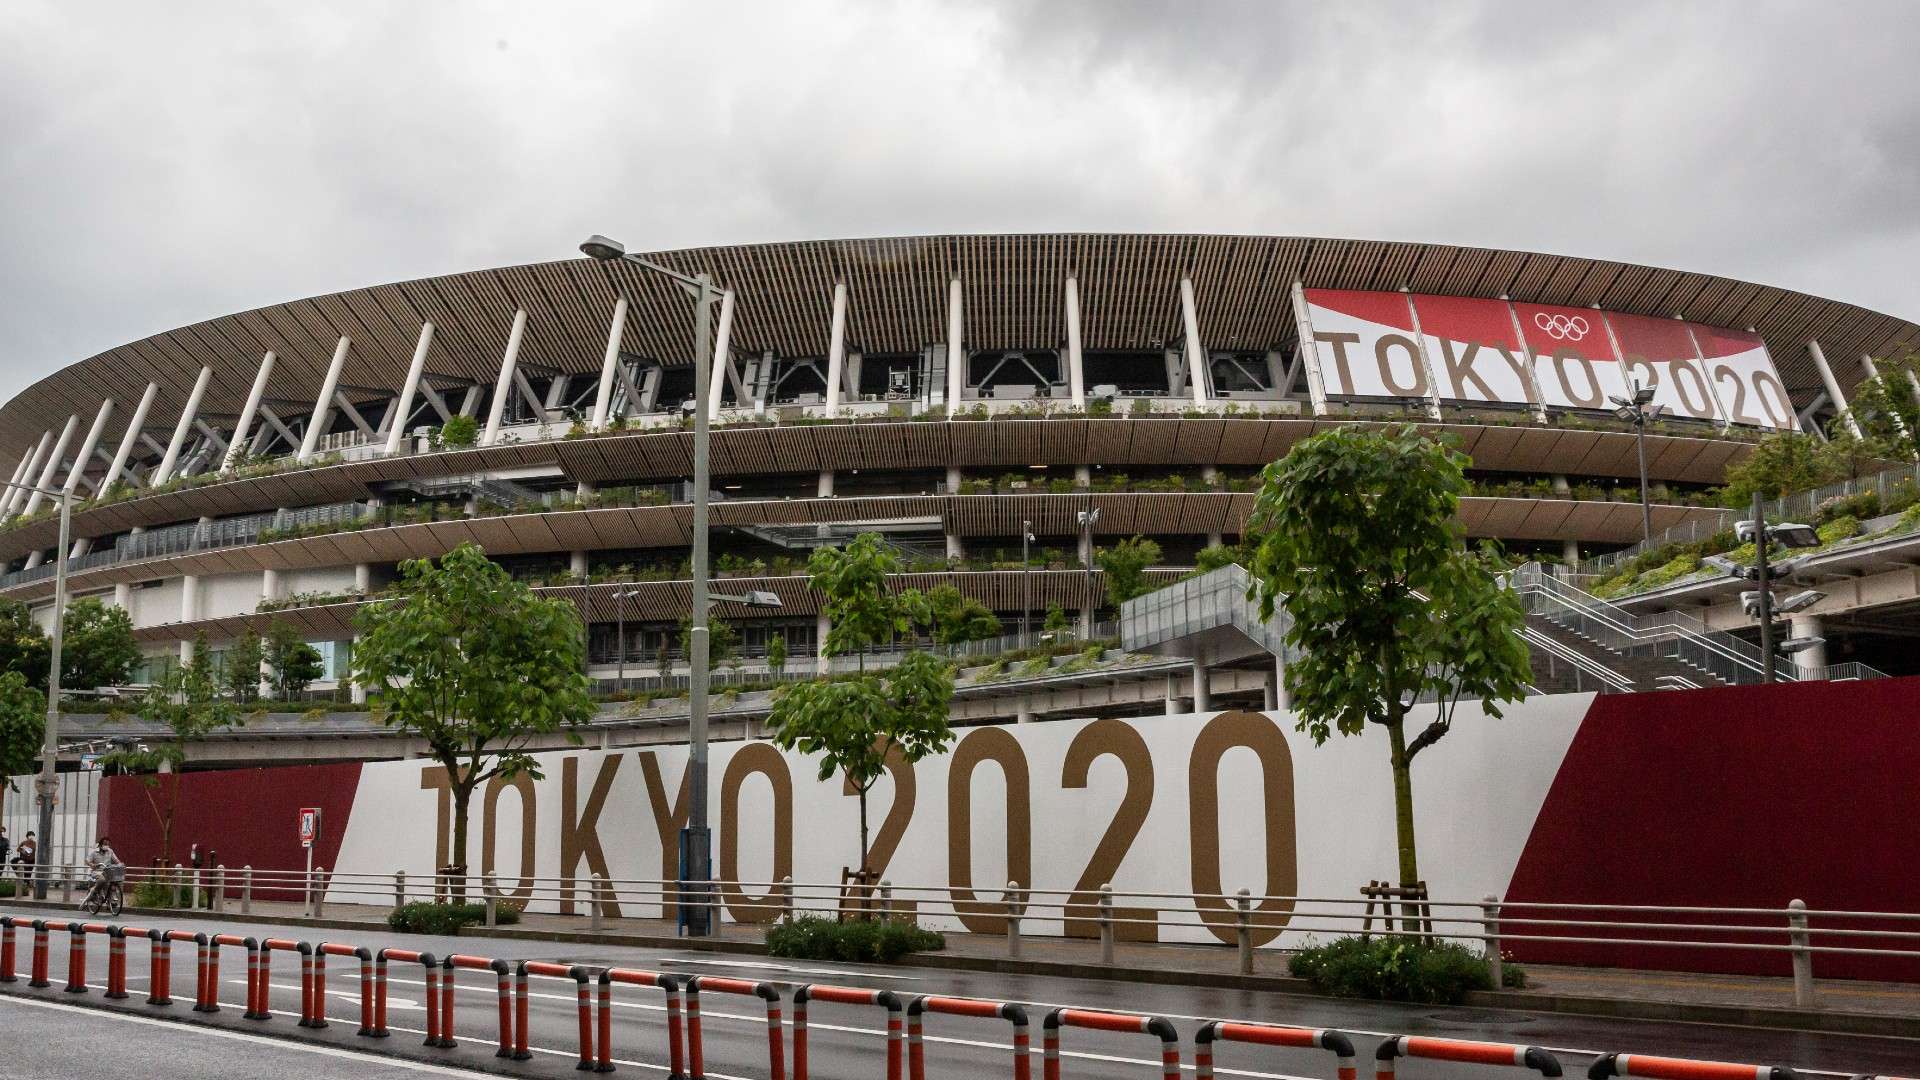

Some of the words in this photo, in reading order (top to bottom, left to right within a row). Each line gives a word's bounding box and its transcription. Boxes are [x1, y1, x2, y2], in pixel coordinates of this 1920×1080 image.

[1313, 331, 1604, 409] TOKYO
[1623, 353, 1797, 430] 2020
[421, 742, 793, 924] TOKYO
[841, 710, 1298, 948] 2020
